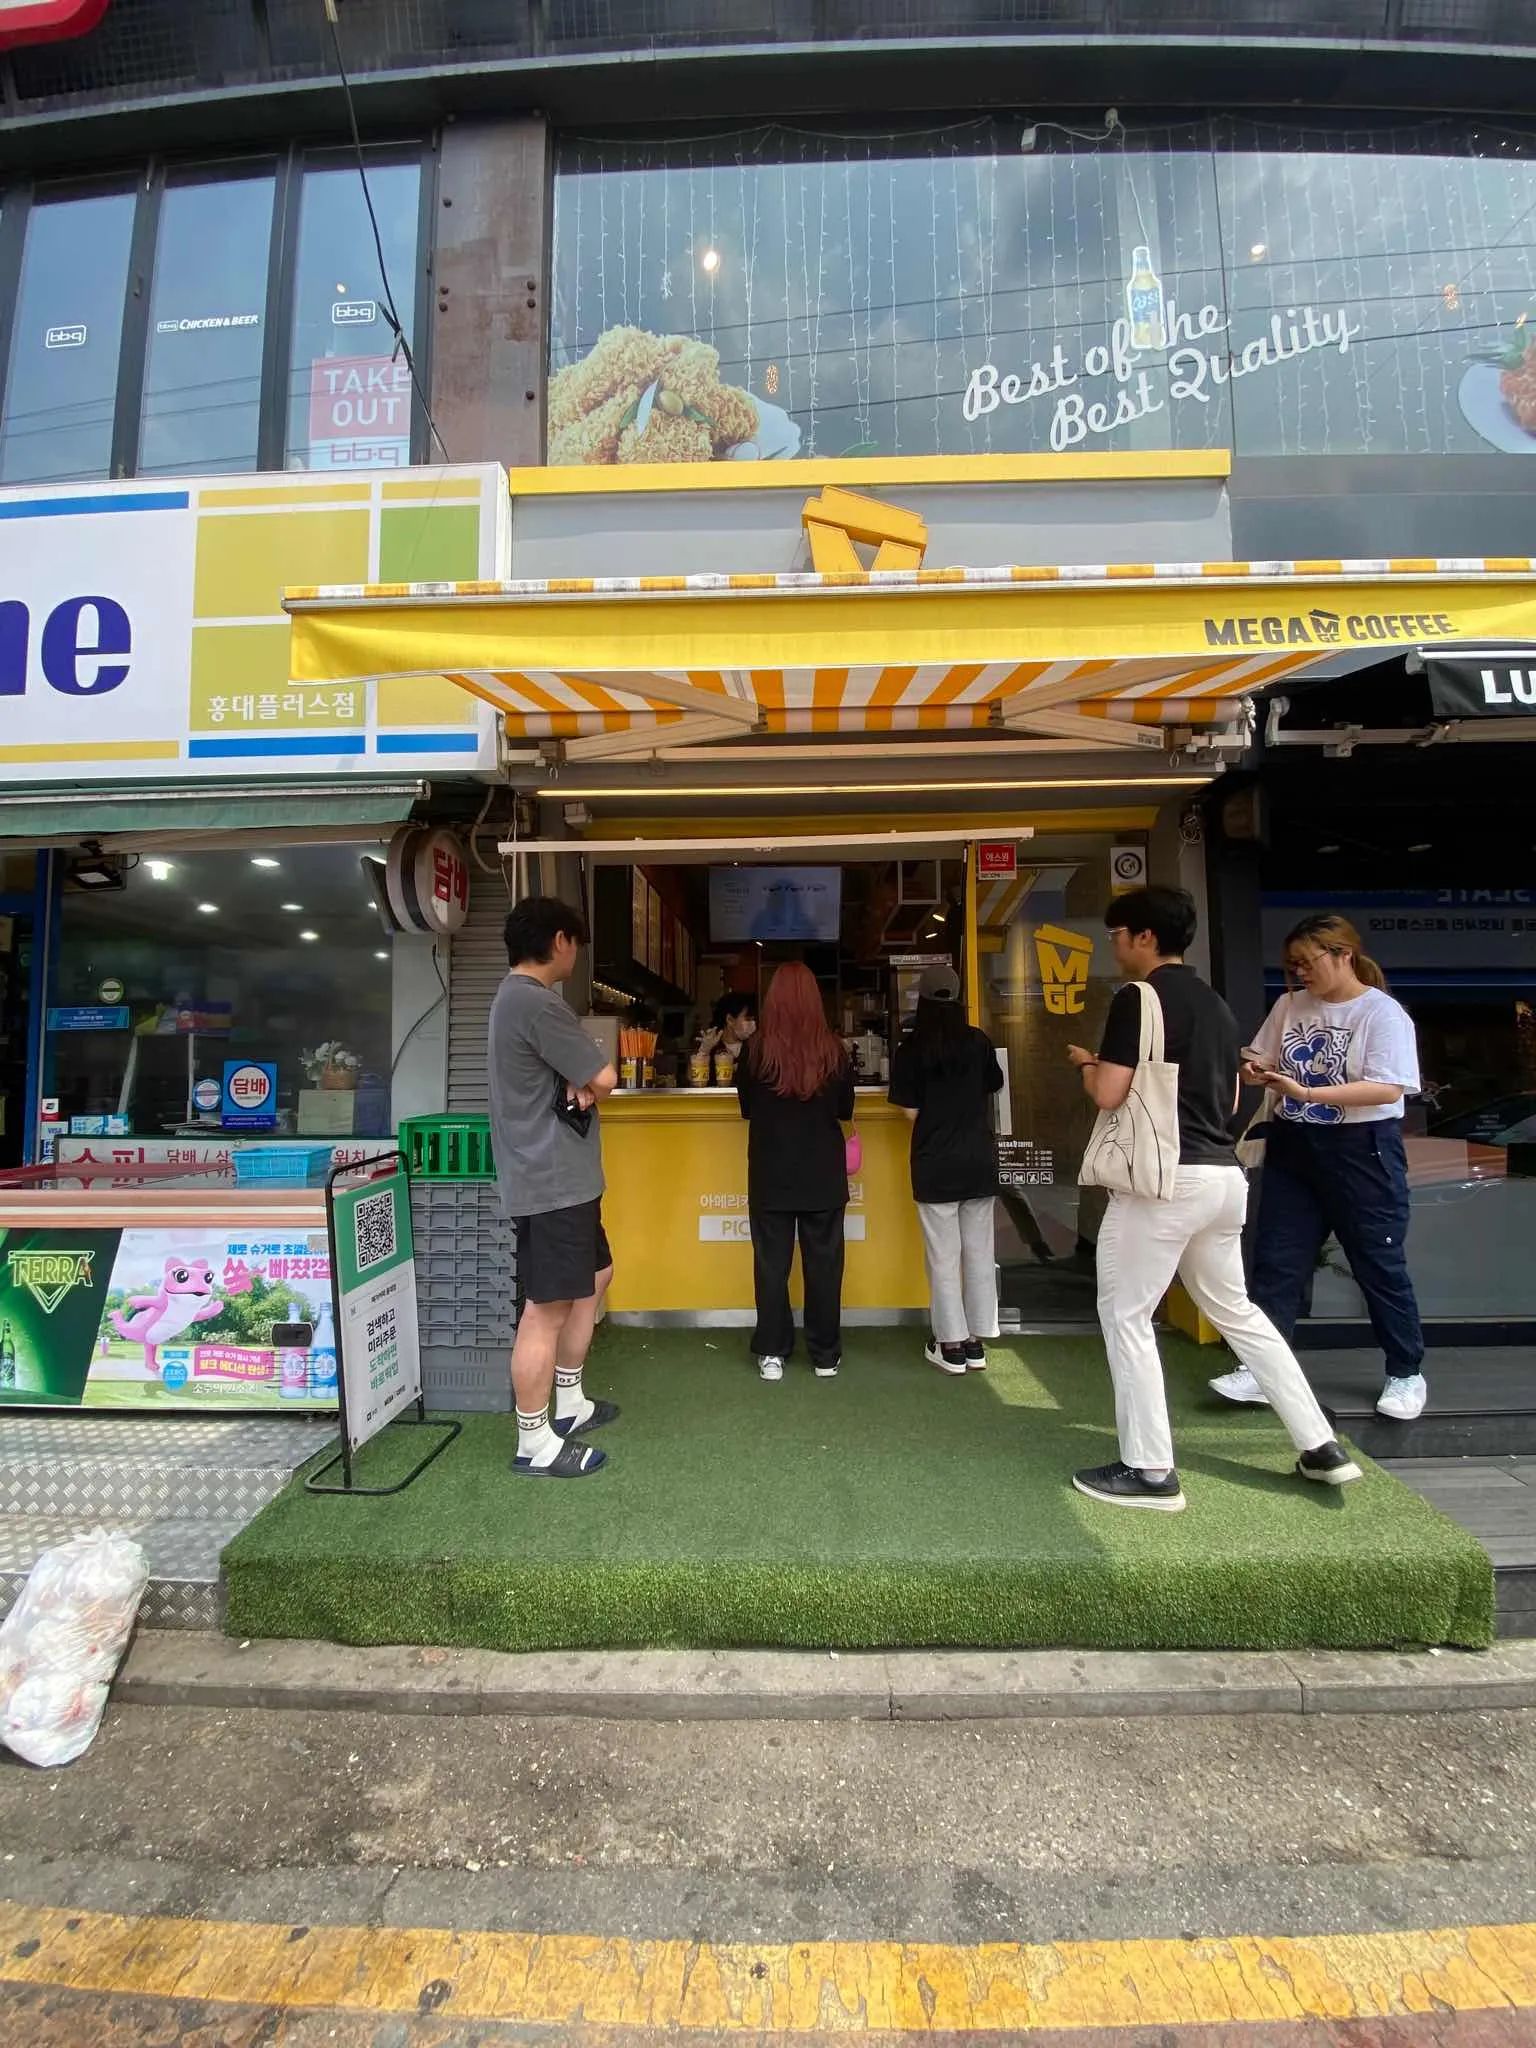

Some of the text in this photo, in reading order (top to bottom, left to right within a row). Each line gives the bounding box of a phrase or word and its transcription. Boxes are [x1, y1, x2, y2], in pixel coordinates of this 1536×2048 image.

[323, 365, 411, 395] TAKE
[962, 345, 1076, 421] Best
[1085, 317, 1141, 383] of
[1050, 305, 1360, 451] Best Quality
[332, 397, 401, 427] OUT
[1204, 617, 1312, 645] MEGA
[1349, 614, 1460, 641] COFFEE
[208, 691, 355, 722] 홍대플러스점
[1042, 983, 1087, 1014] GC
[233, 1078, 266, 1095] 담배
[8, 1256, 94, 1287] TERRA
[366, 1308, 396, 1337] 검색하고
[367, 1325, 397, 1353] 미리주문
